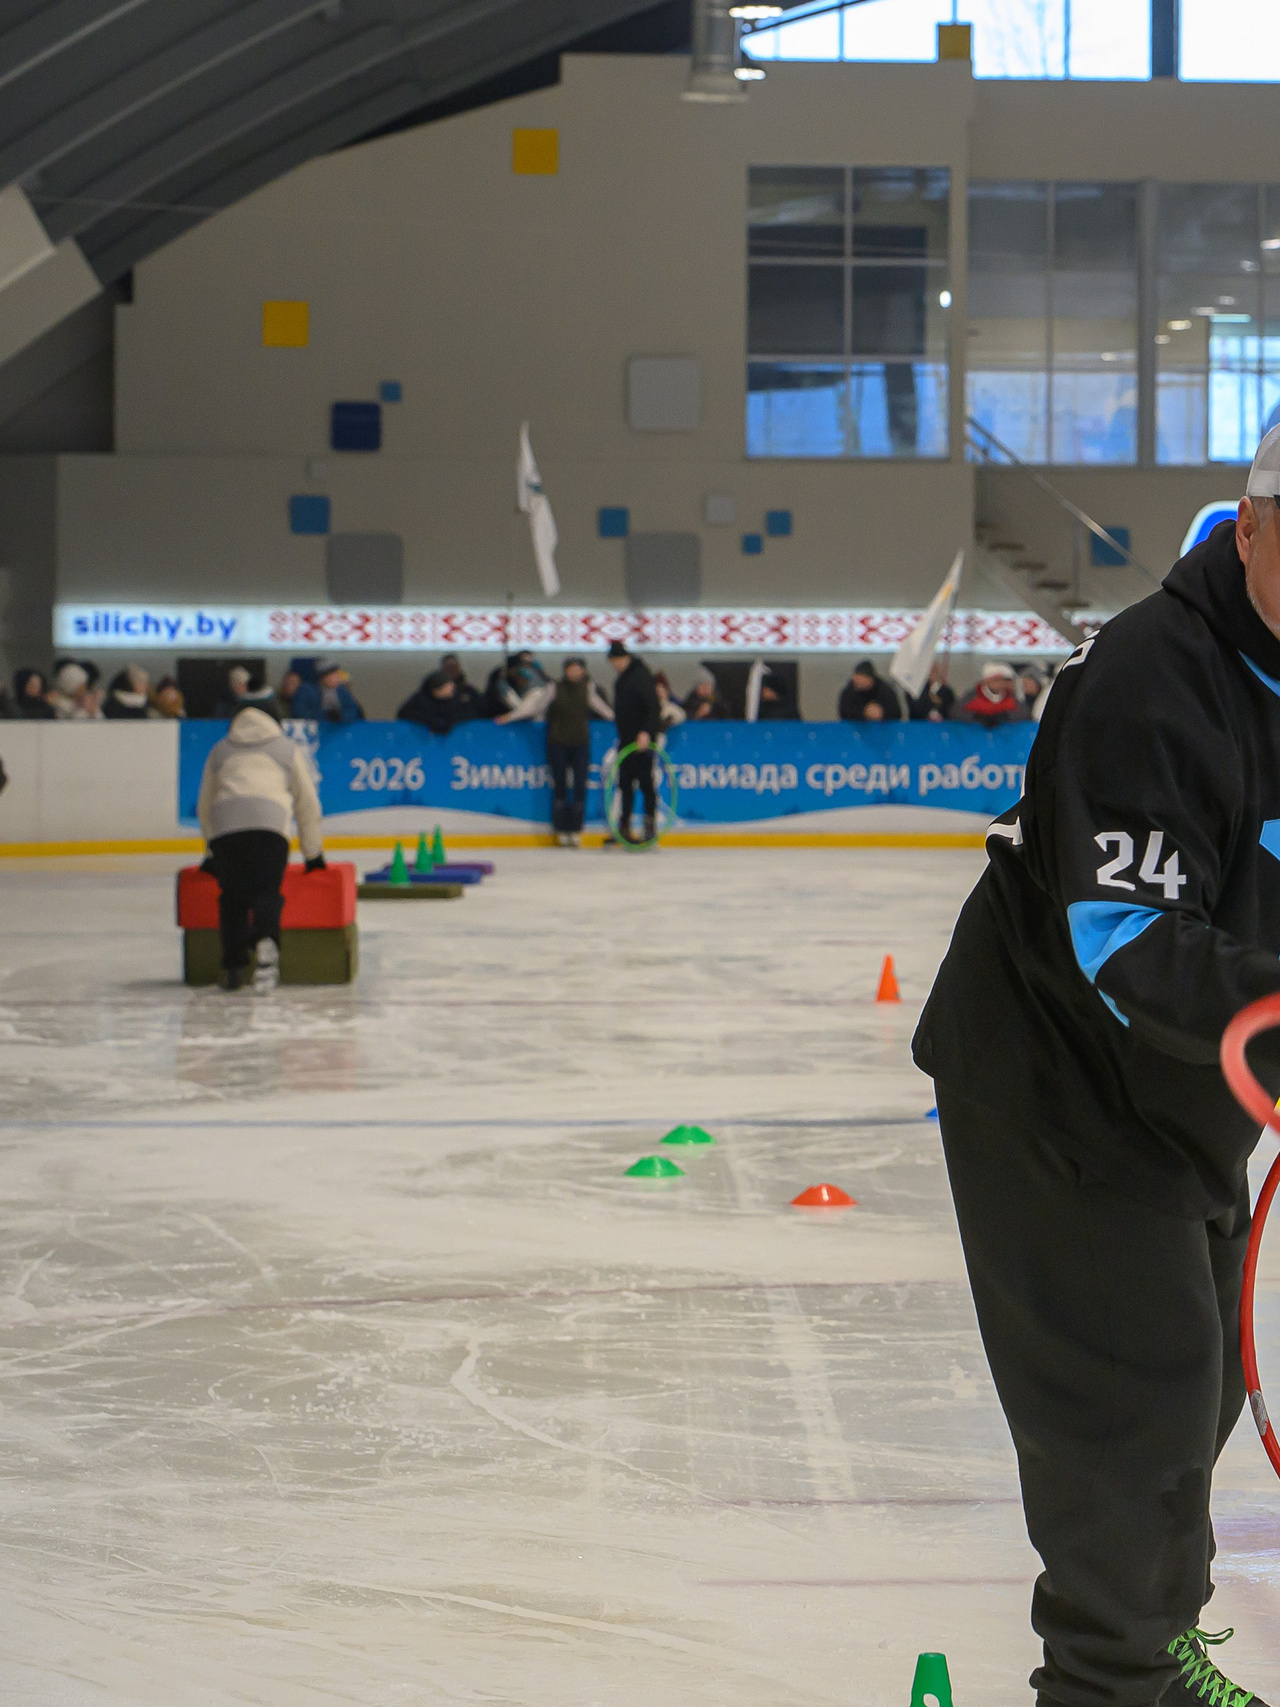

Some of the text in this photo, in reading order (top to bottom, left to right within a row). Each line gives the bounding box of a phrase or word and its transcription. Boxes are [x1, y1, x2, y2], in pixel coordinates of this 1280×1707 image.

[74, 610, 238, 642] silichy.by
[350, 757, 426, 791] 2026
[805, 763, 910, 797] среди
[917, 755, 1025, 797] работ
[1094, 831, 1187, 900] 24
